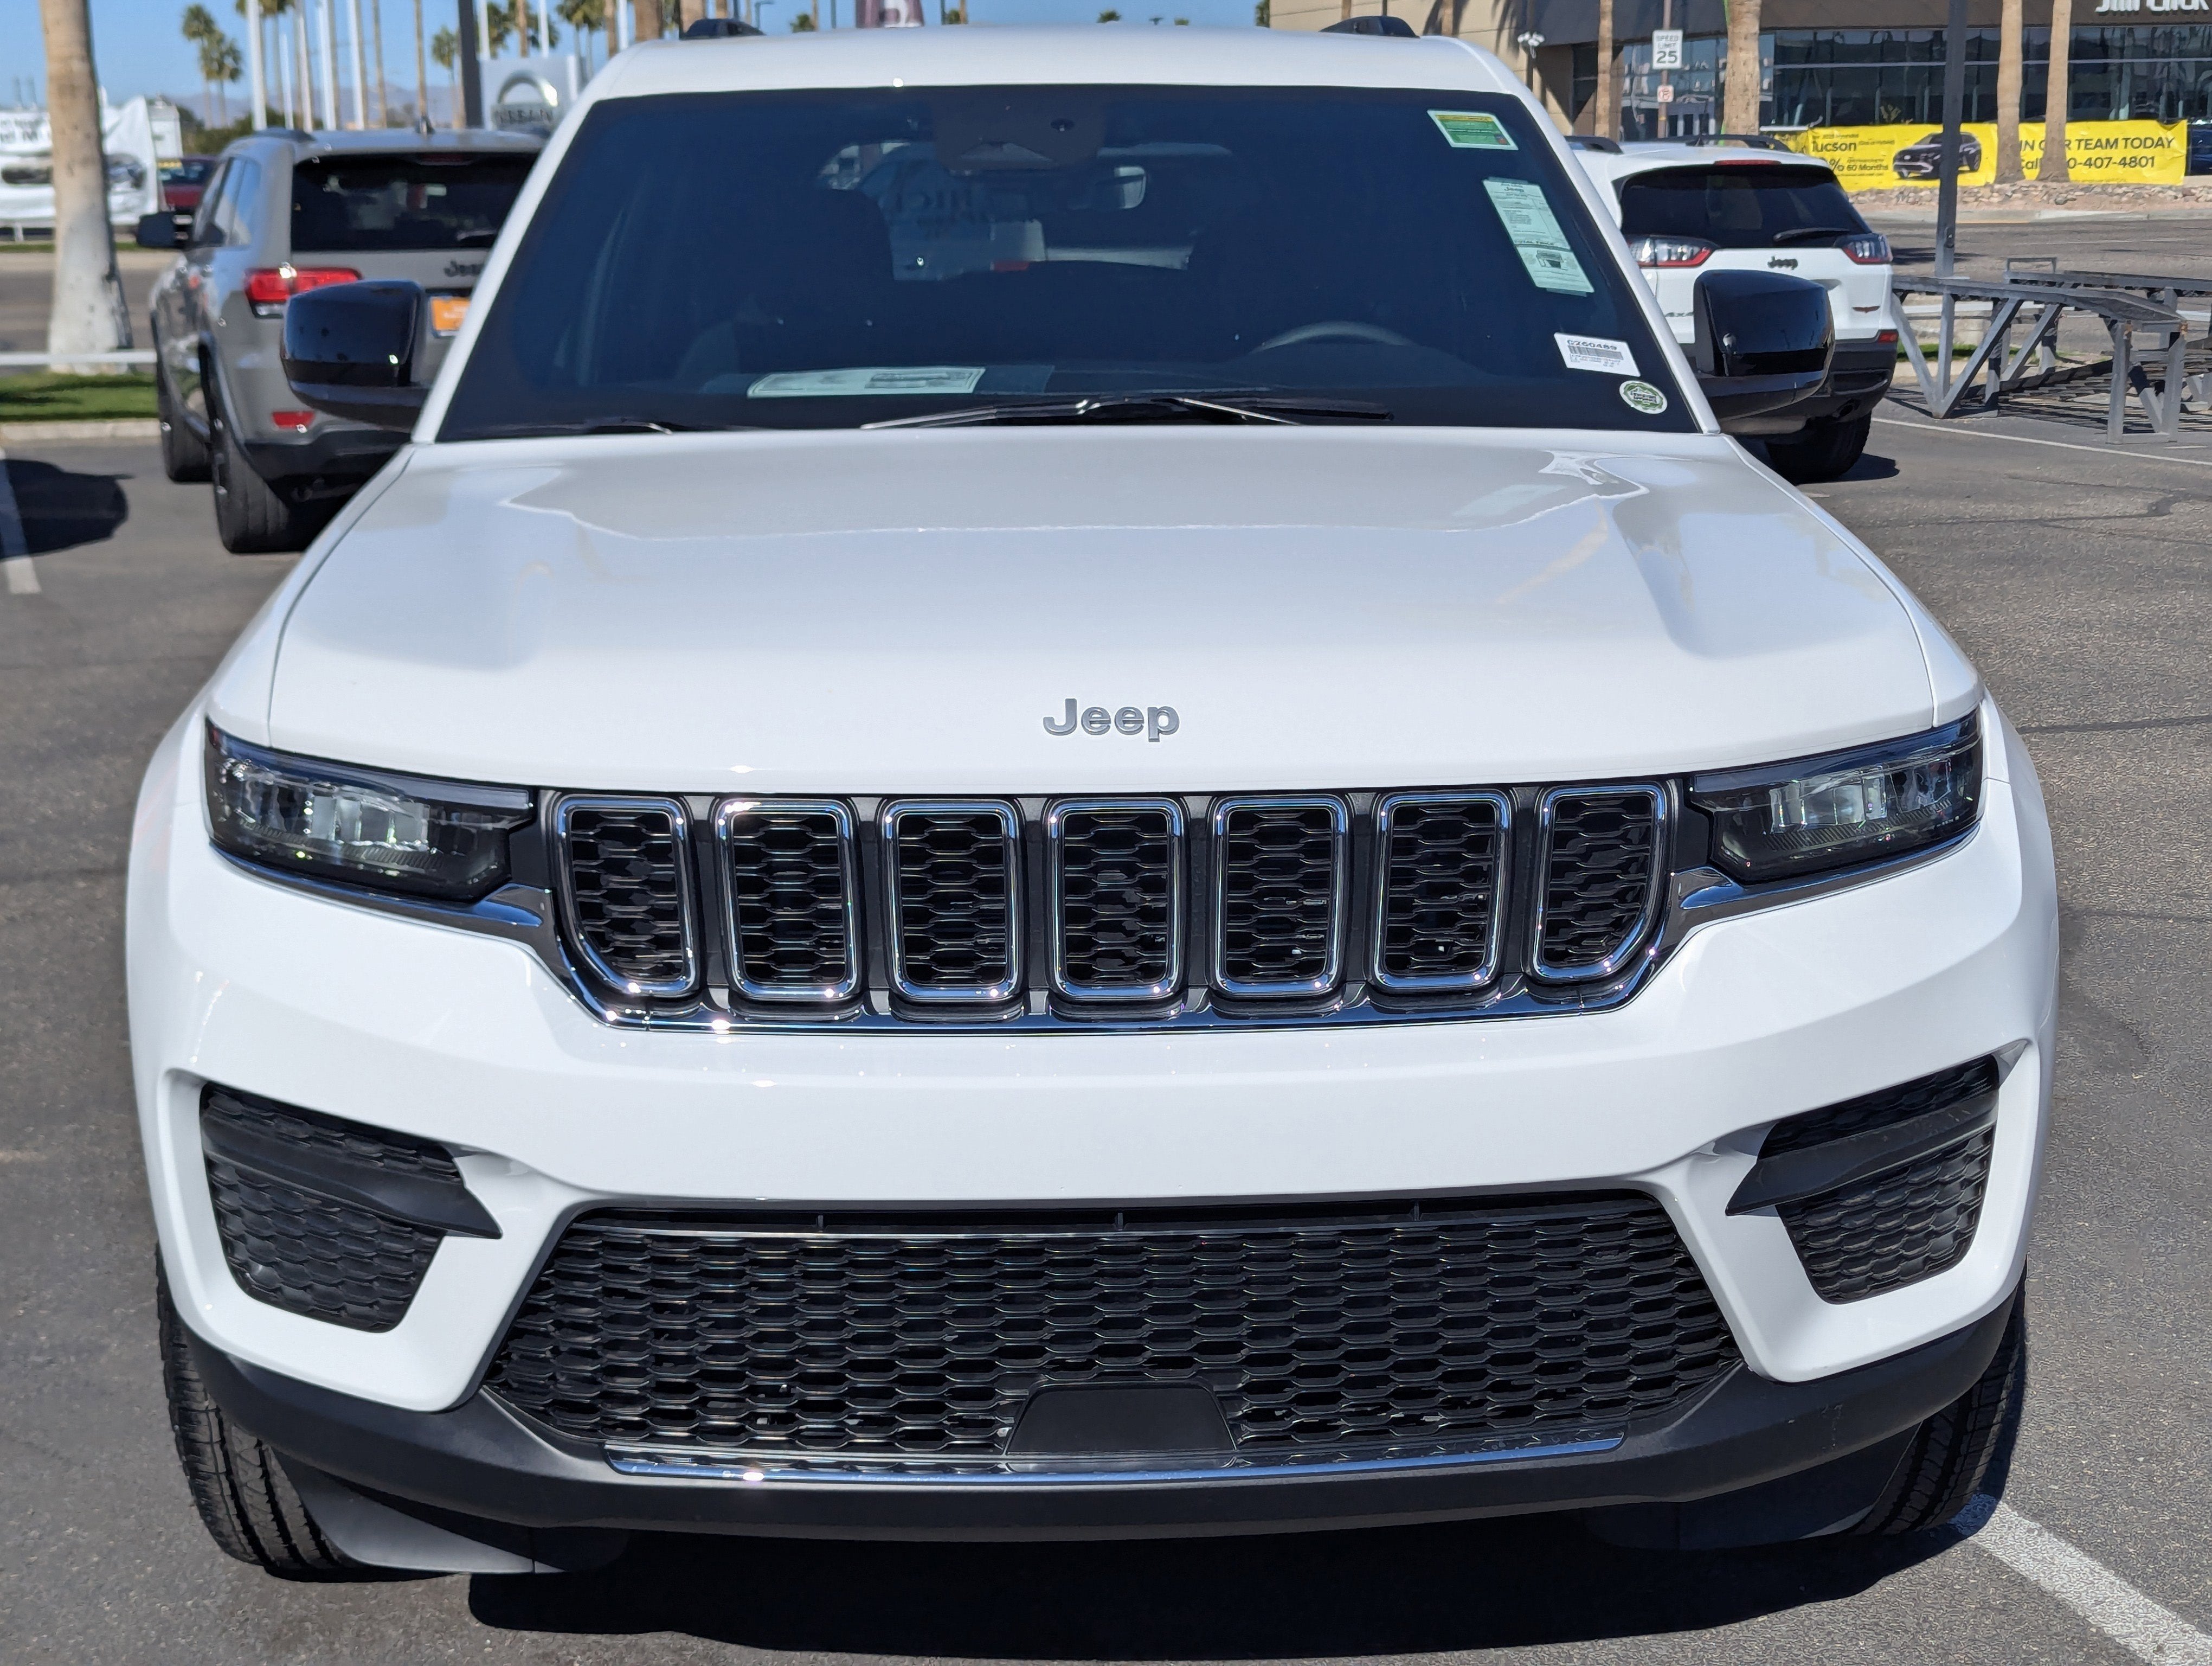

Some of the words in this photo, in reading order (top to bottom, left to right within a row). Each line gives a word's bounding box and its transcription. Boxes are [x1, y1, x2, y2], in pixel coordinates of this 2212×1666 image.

[1657, 50, 1677, 64] 25
[1812, 140, 1857, 152] Tucson
[2076, 138, 2119, 151] TEAM
[2121, 137, 2175, 150] TODAY
[2067, 155, 2156, 170] 0-407-4801
[1767, 256, 1798, 270] Jeep
[1043, 698, 1180, 742] Jeep
